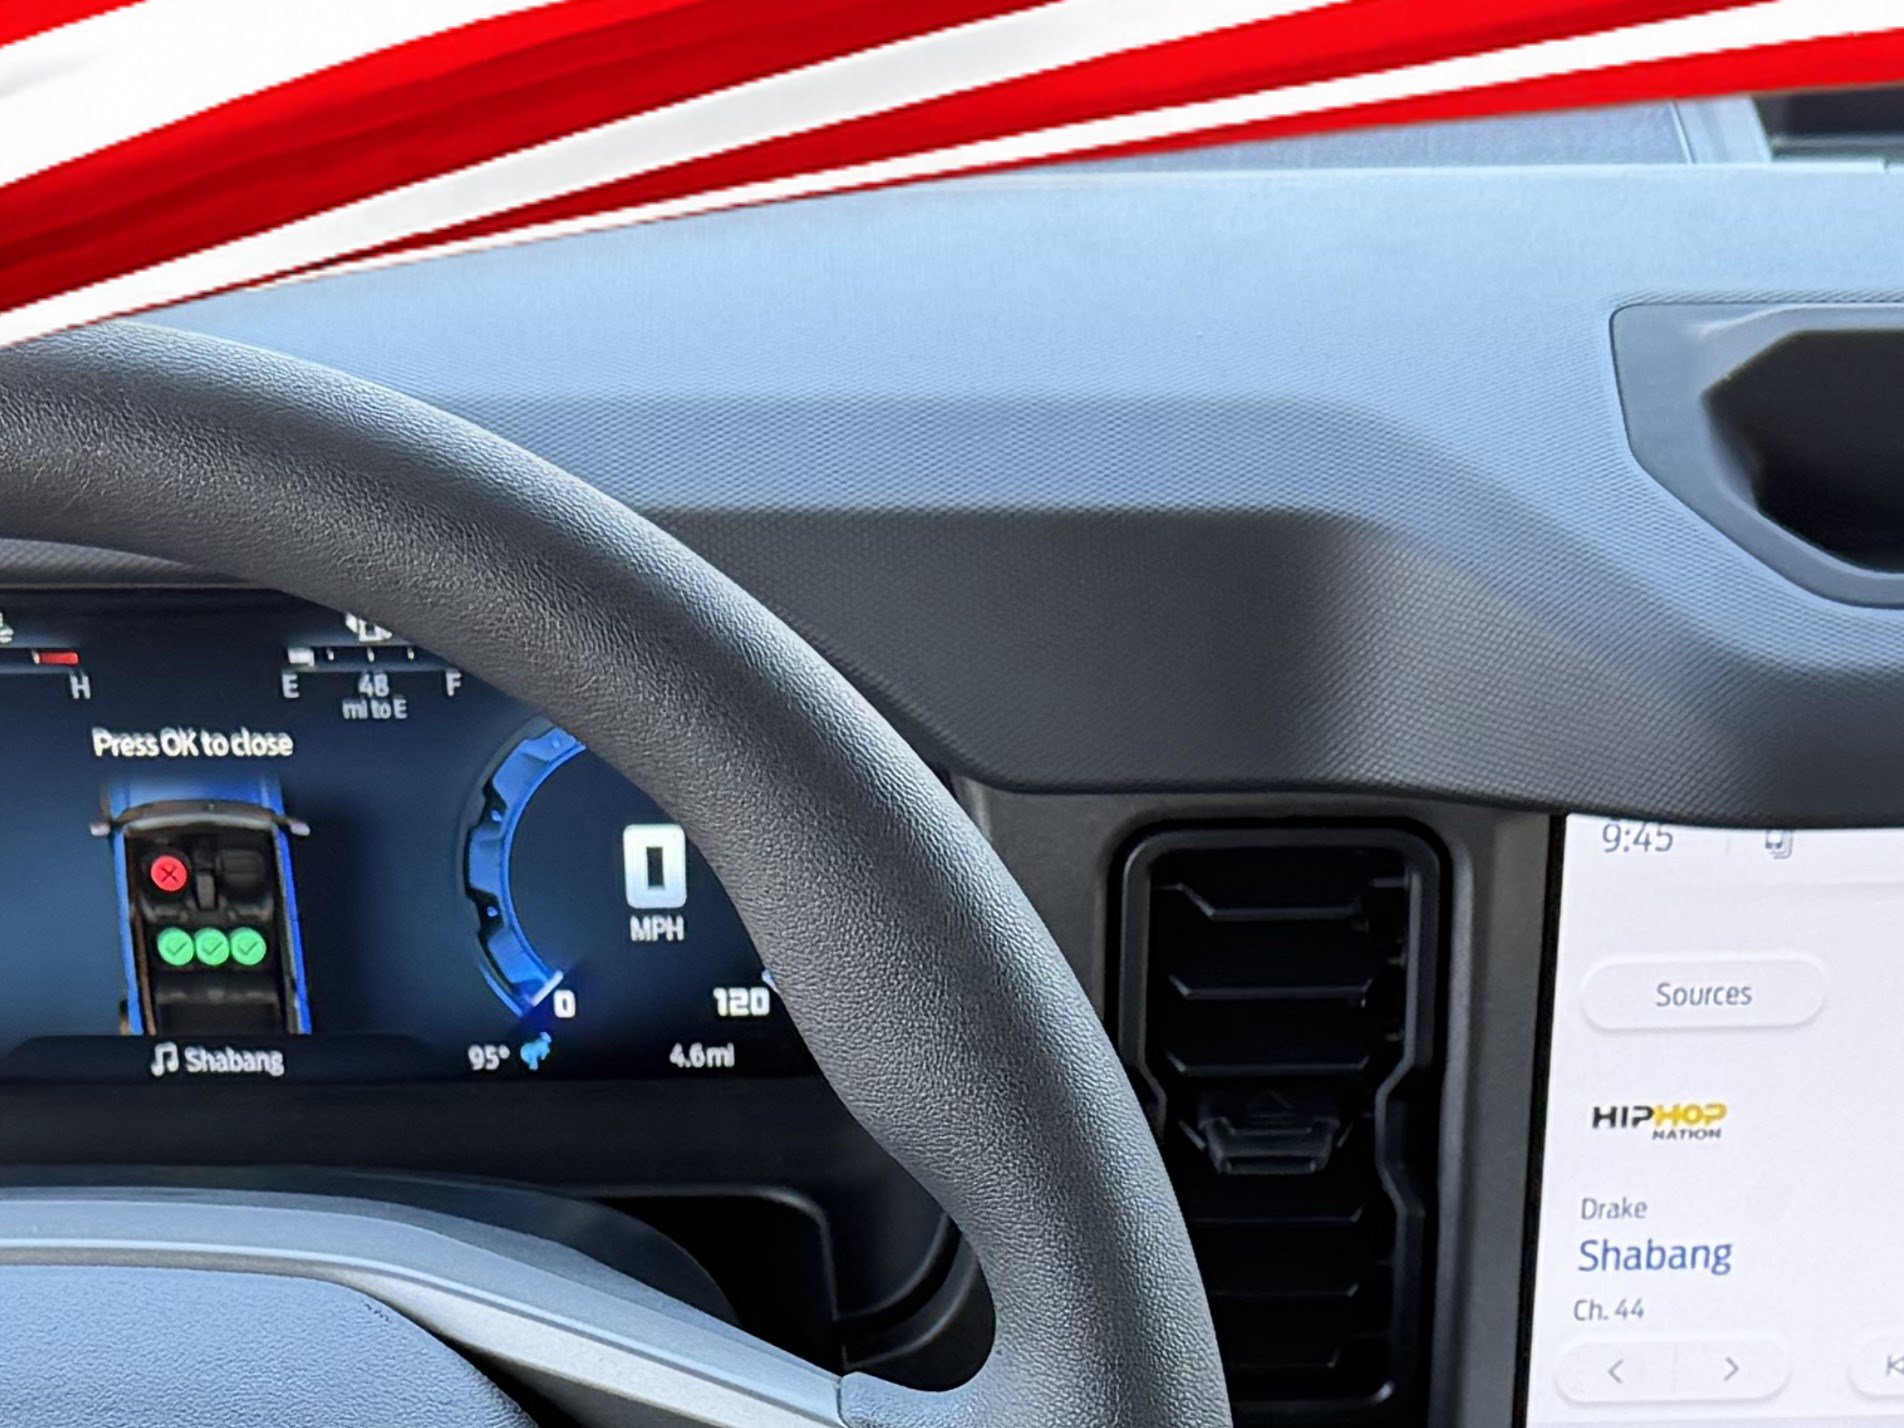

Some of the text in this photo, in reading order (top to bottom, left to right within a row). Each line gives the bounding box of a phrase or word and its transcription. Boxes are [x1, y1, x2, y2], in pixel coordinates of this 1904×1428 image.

[69, 675, 91, 701] H
[280, 673, 300, 699] E
[357, 672, 390, 698] 48
[446, 672, 463, 698] F
[92, 729, 295, 759] Press OK to close
[1601, 822, 1675, 854] 9:45
[622, 822, 688, 910] 0
[628, 916, 686, 943] MPH
[553, 989, 576, 1019] 0
[712, 987, 771, 1017] 120
[1654, 981, 1754, 1009] Sources
[184, 1045, 286, 1078] Shabang
[1651, 1127, 1723, 1141] NATION
[1580, 1196, 1648, 1222] Drake
[1577, 1238, 1734, 1276] Shabang
[1572, 1297, 1646, 1323] Ch. 44
